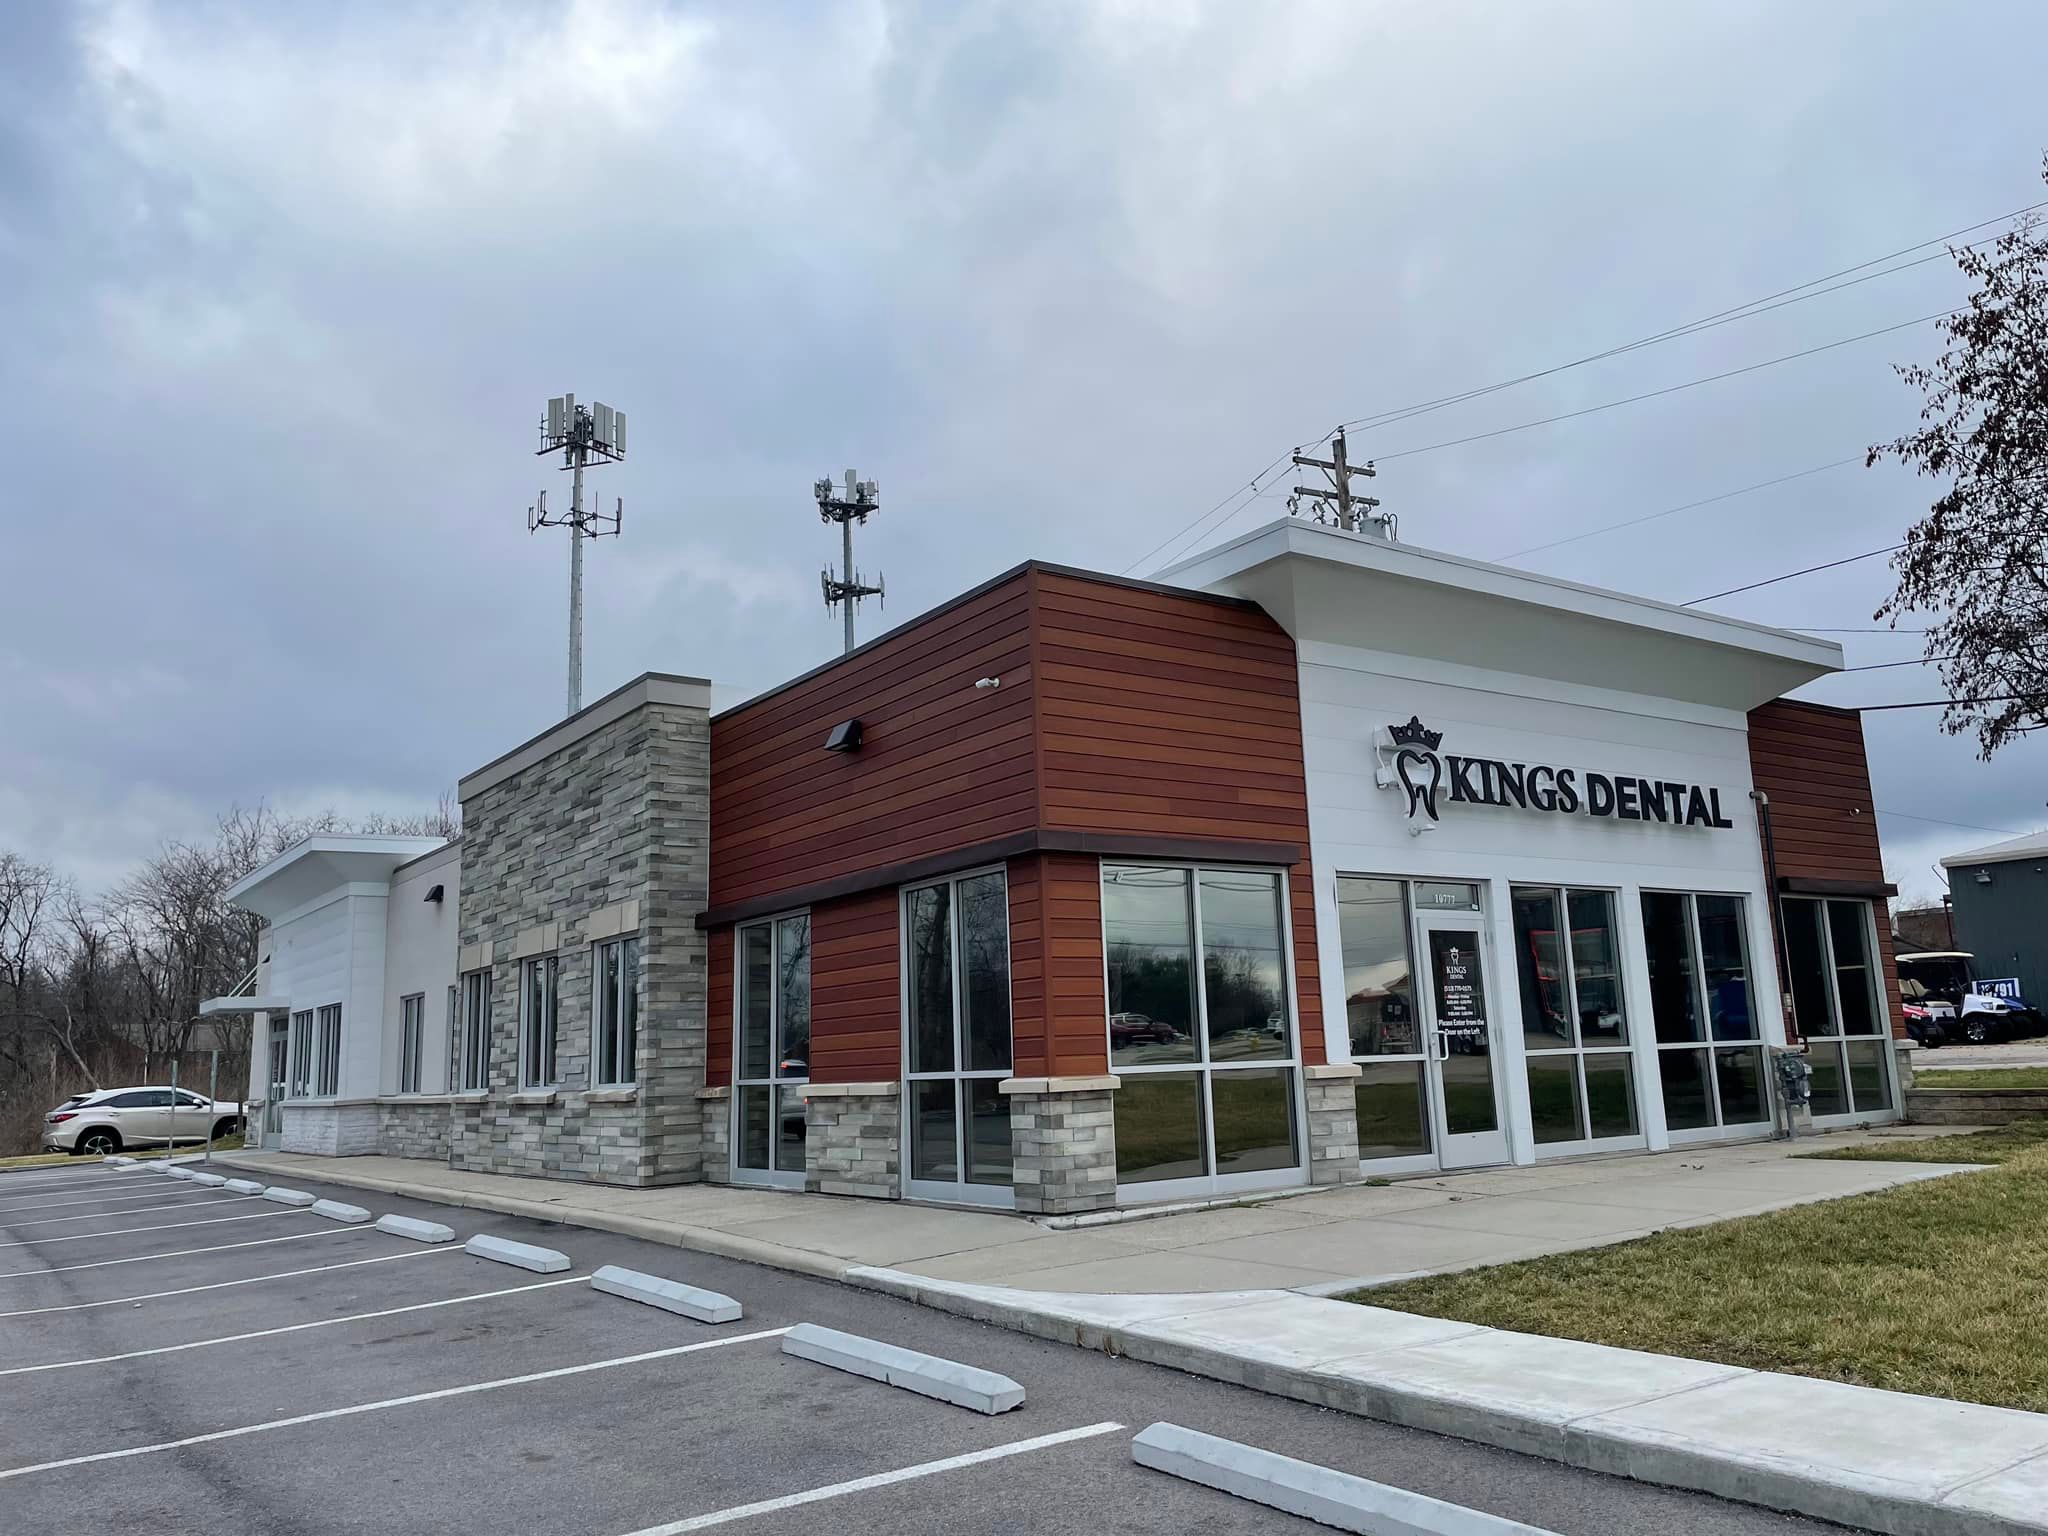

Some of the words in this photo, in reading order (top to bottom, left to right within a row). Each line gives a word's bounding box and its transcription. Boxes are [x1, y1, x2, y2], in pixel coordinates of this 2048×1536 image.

[1444, 755, 1578, 814] KINGS
[1585, 773, 1733, 829] DENTAL
[1446, 966, 1467, 974] KINGS
